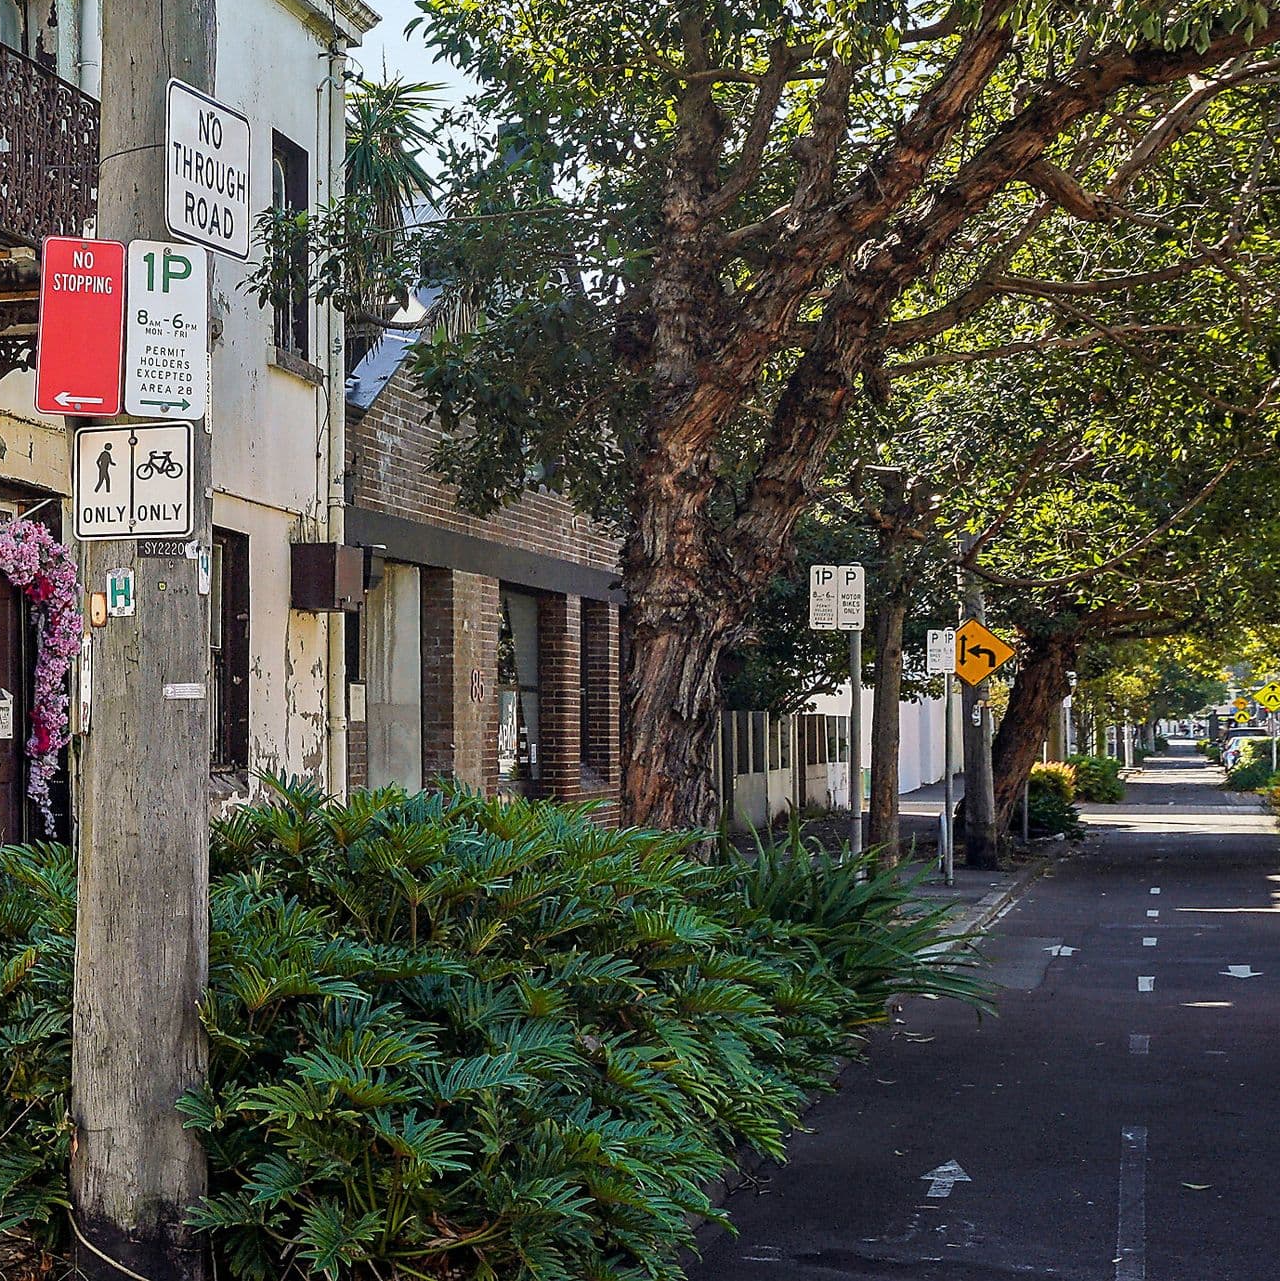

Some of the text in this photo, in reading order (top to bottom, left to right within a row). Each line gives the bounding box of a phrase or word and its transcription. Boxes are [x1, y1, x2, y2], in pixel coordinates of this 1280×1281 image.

[198, 109, 223, 150] NO
[173, 141, 246, 204] THROUGH
[185, 190, 234, 240] ROAD
[73, 251, 94, 269] NO
[143, 252, 193, 293] 1P
[53, 273, 113, 295] STOPPING
[145, 327, 163, 336] MON
[174, 330, 188, 338] FRI
[145, 345, 185, 358] PERMIT
[140, 356, 190, 370] HOLDERS
[137, 368, 192, 382] EXCEPTED
[140, 383, 192, 396] AREA 28
[83, 505, 126, 524] ONLY
[137, 503, 183, 522] ONLY
[815, 570, 833, 585] 1P
[845, 571, 857, 586] P
[111, 577, 131, 608] H
[843, 607, 860, 615] ONLY
[931, 632, 939, 644] P
